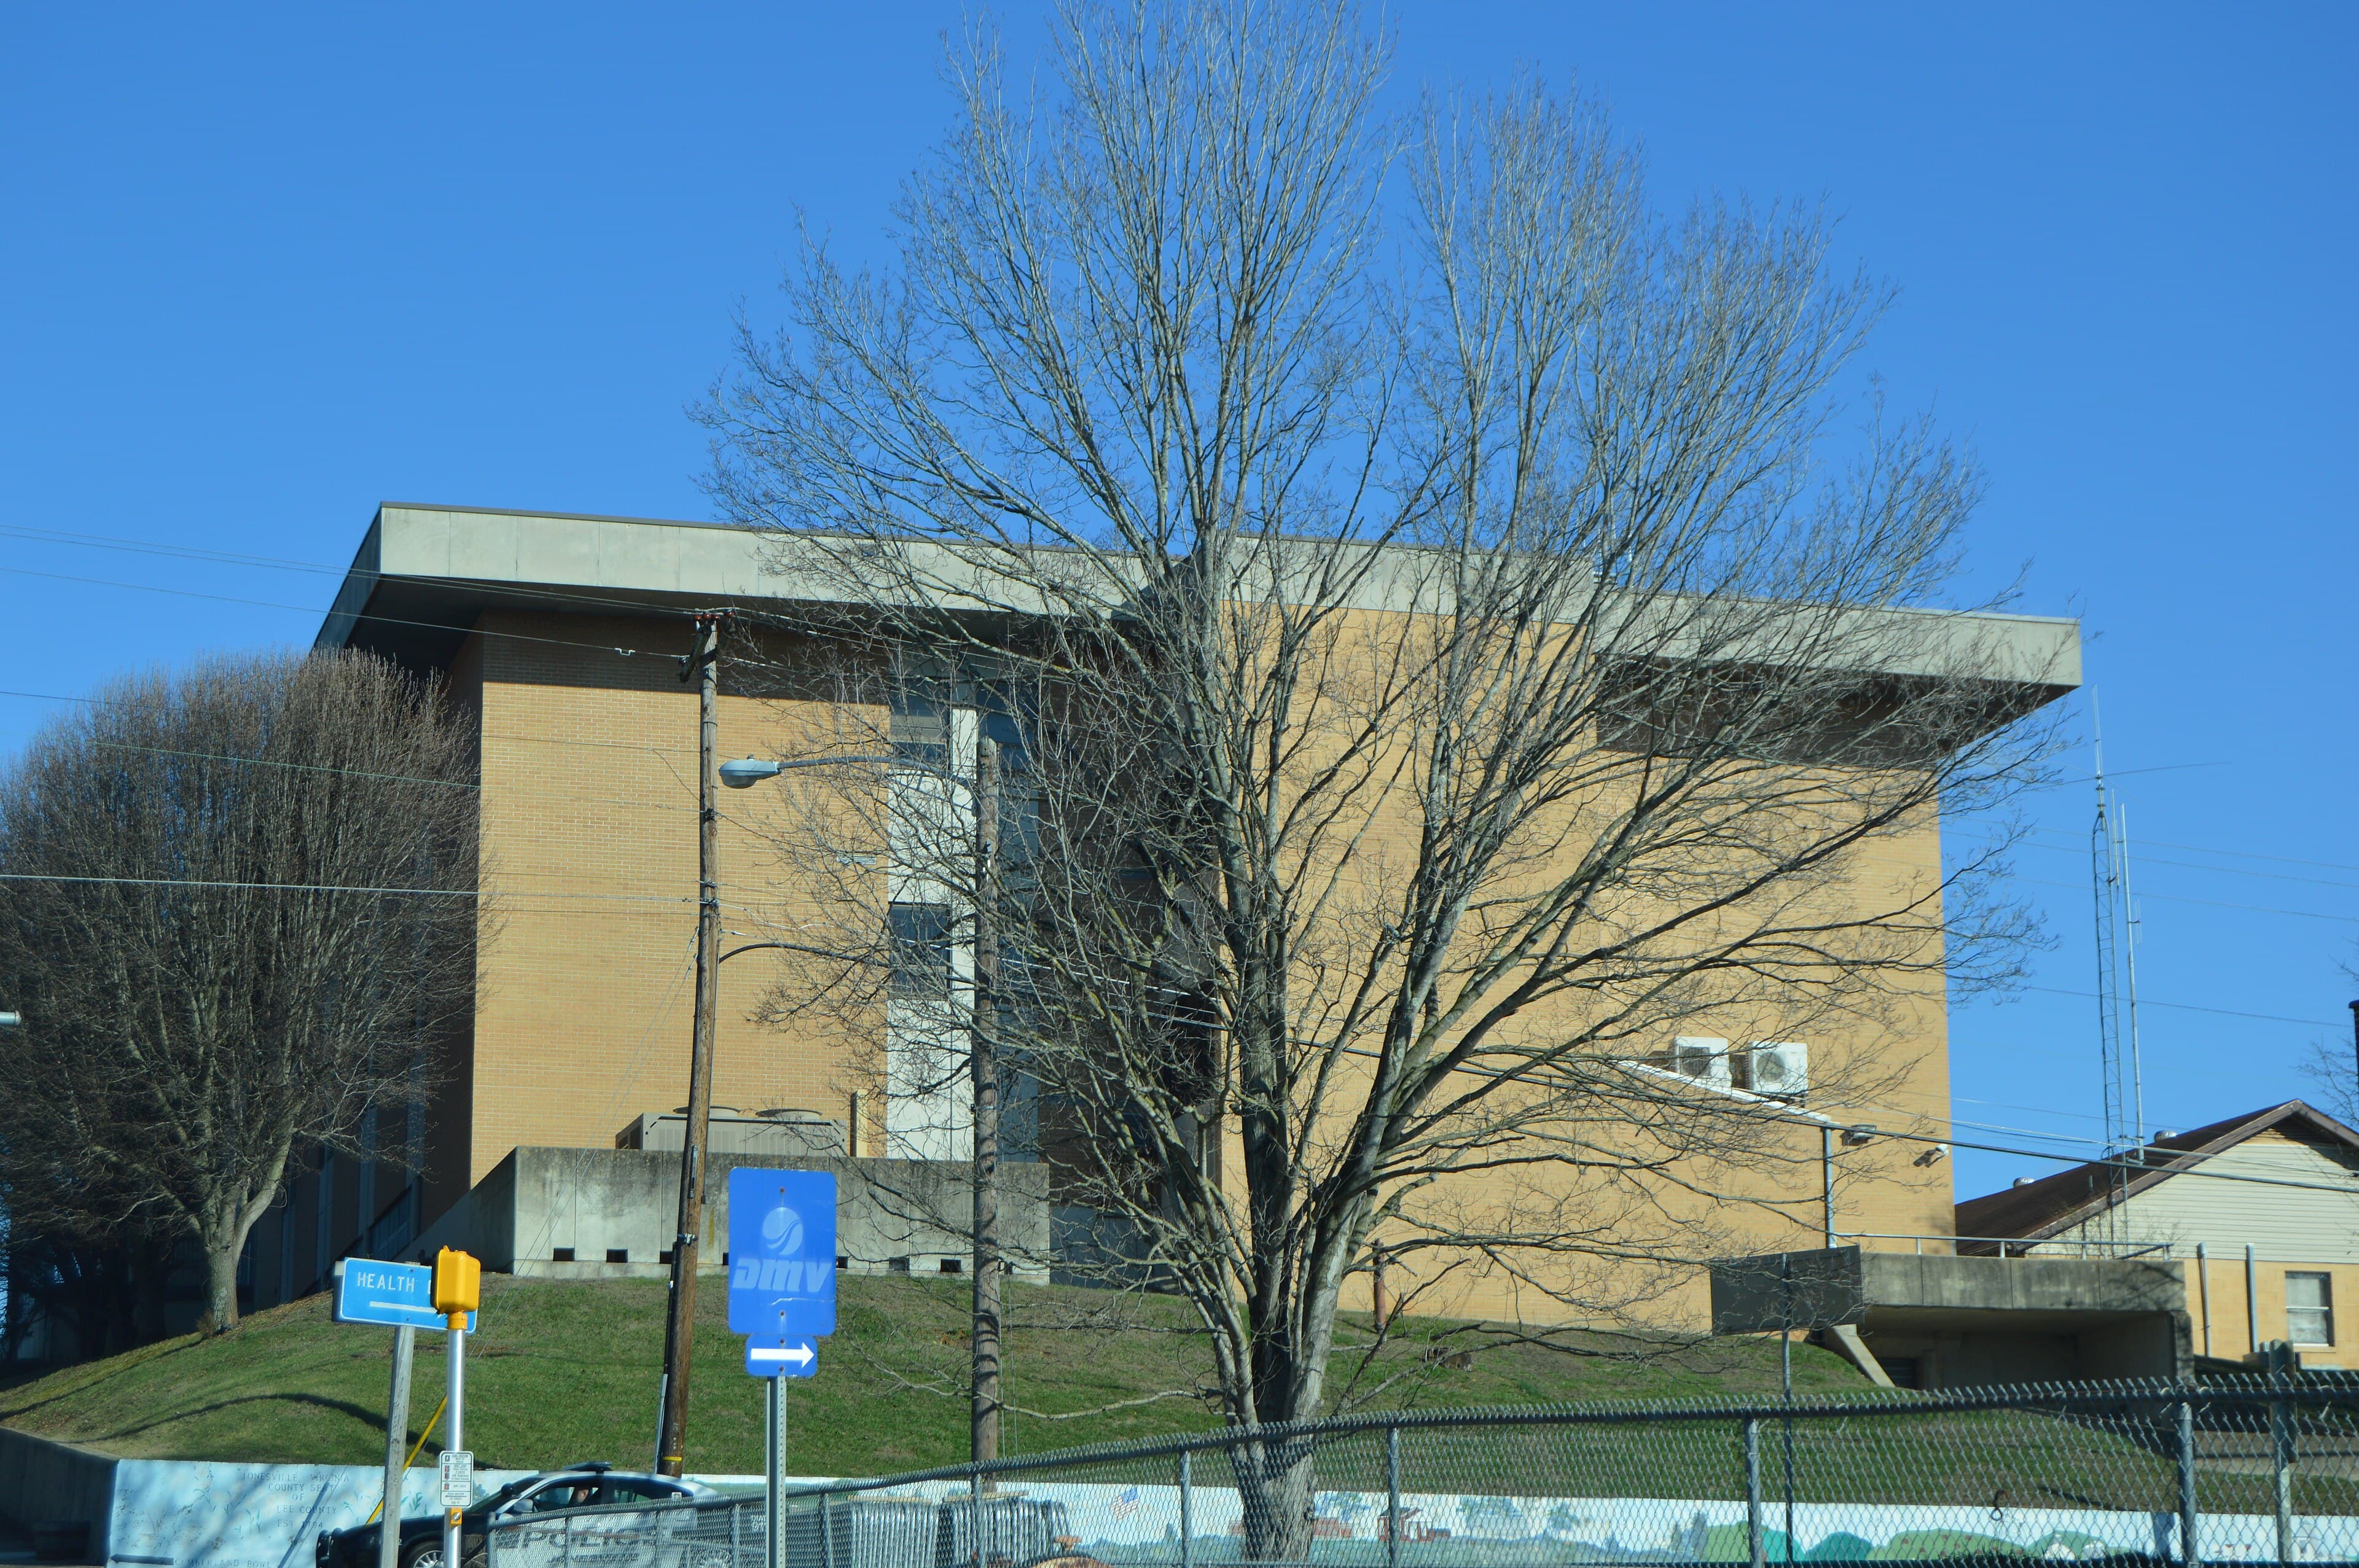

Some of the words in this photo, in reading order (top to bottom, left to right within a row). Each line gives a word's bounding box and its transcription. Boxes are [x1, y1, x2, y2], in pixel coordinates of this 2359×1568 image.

[357, 1271, 415, 1292] HEALTH
[732, 1258, 832, 1292] DMV
[247, 1559, 271, 1568] BOWL
